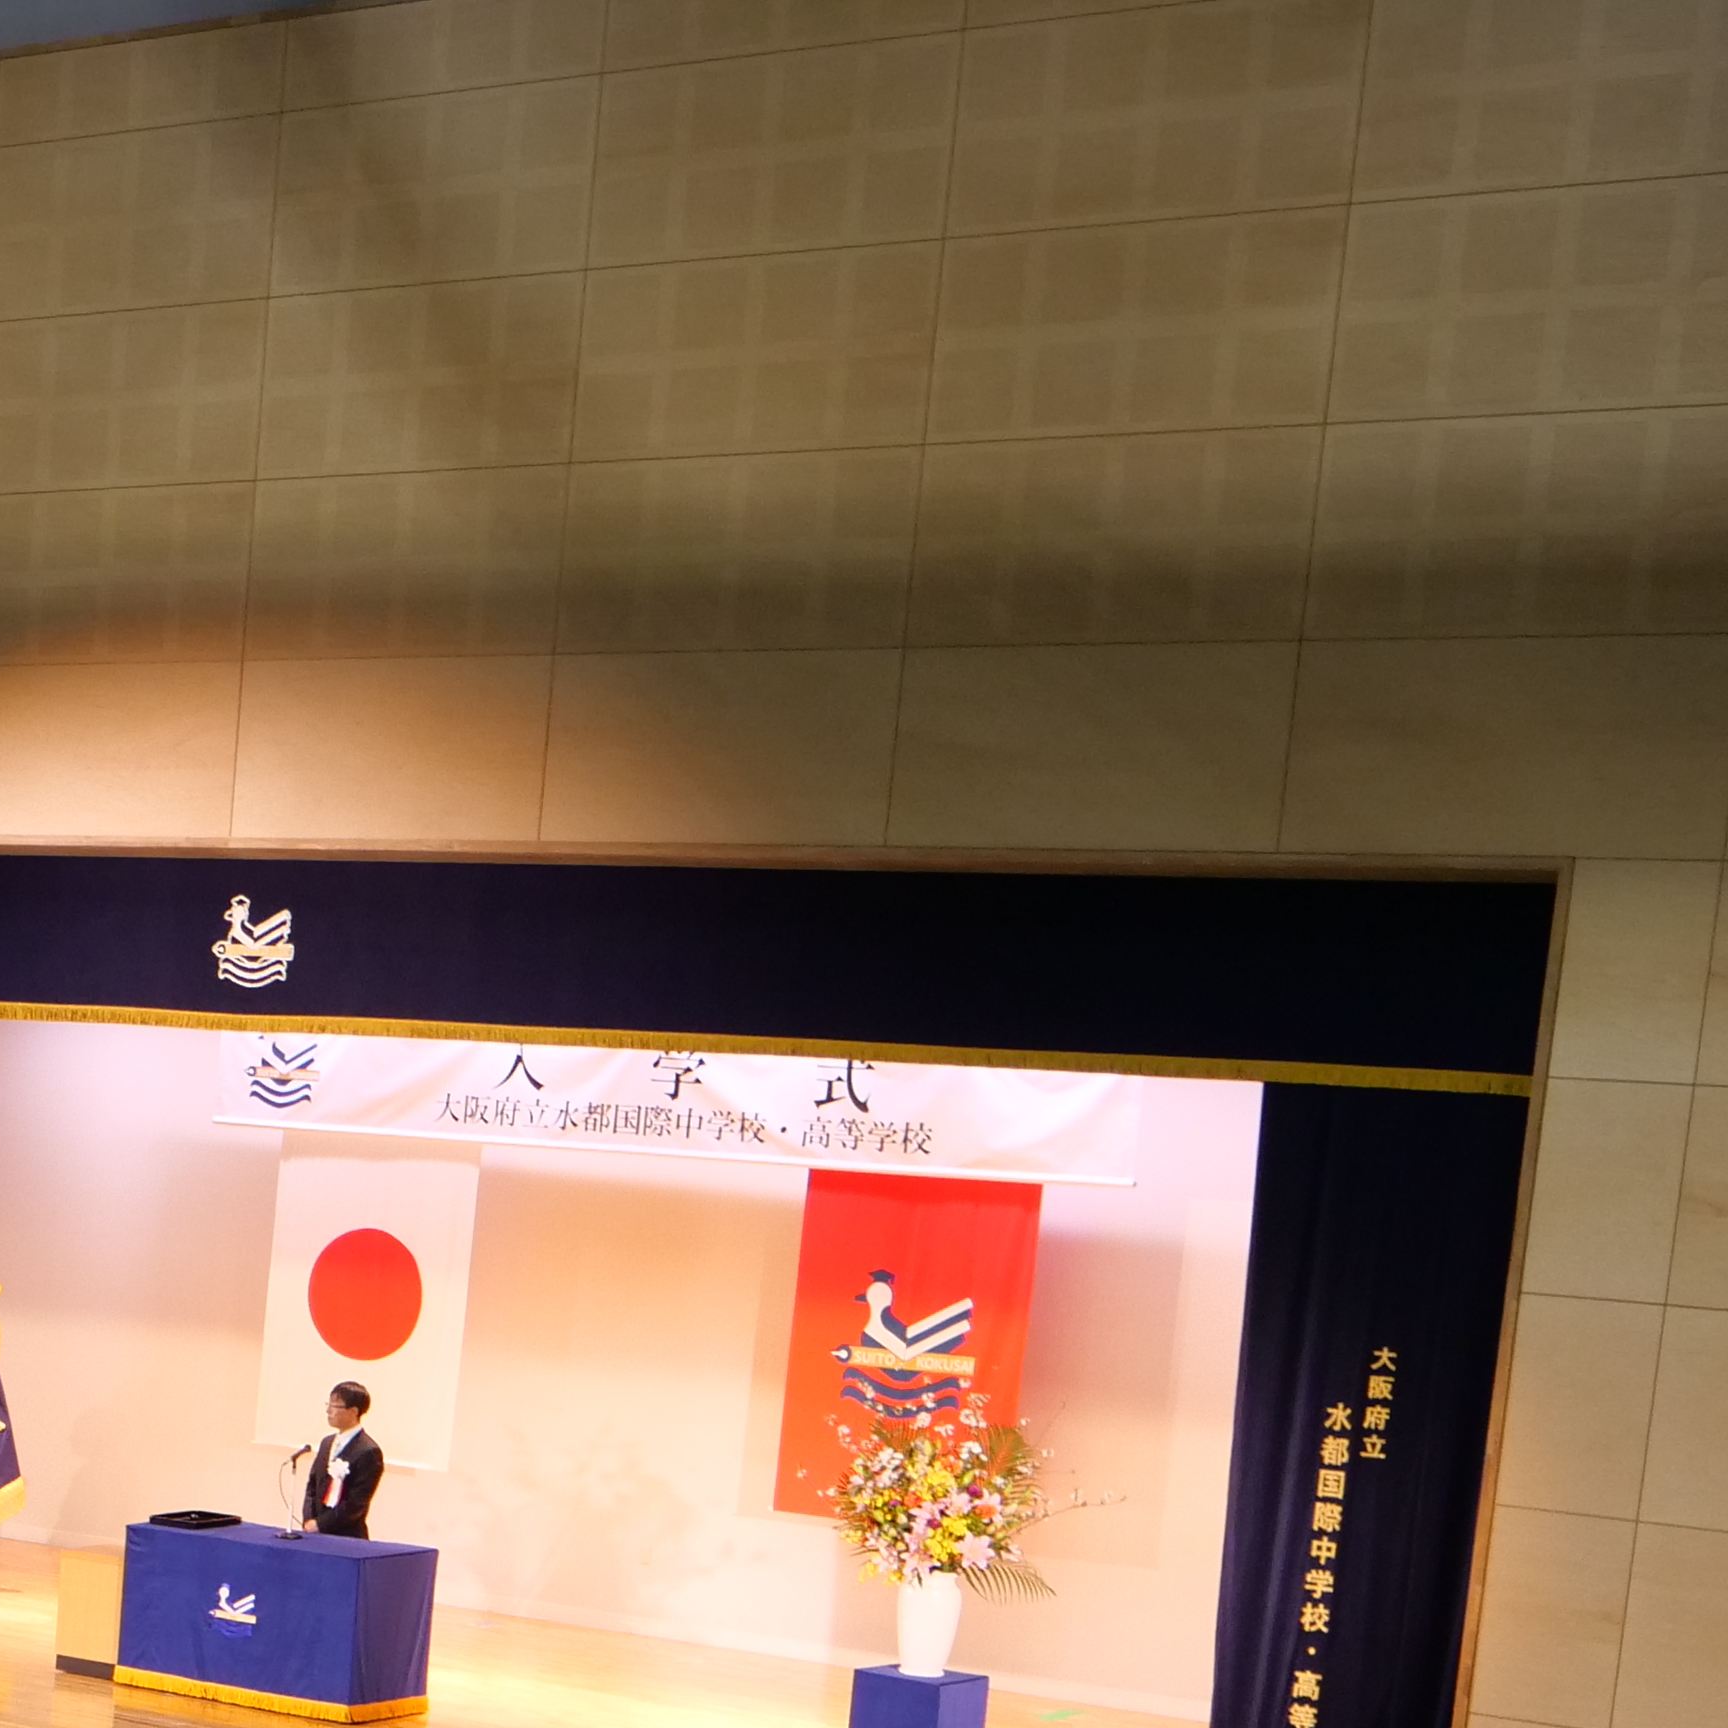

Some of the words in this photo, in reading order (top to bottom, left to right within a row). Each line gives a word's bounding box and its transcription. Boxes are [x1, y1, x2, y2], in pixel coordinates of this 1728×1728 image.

[436, 1093, 933, 1156] 大阪府立水都国際中学校・高等学校
[854, 1351, 895, 1367] SUITO
[915, 1356, 975, 1374] KOKUSAI
[1359, 1346, 1398, 1460] 大阪府立
